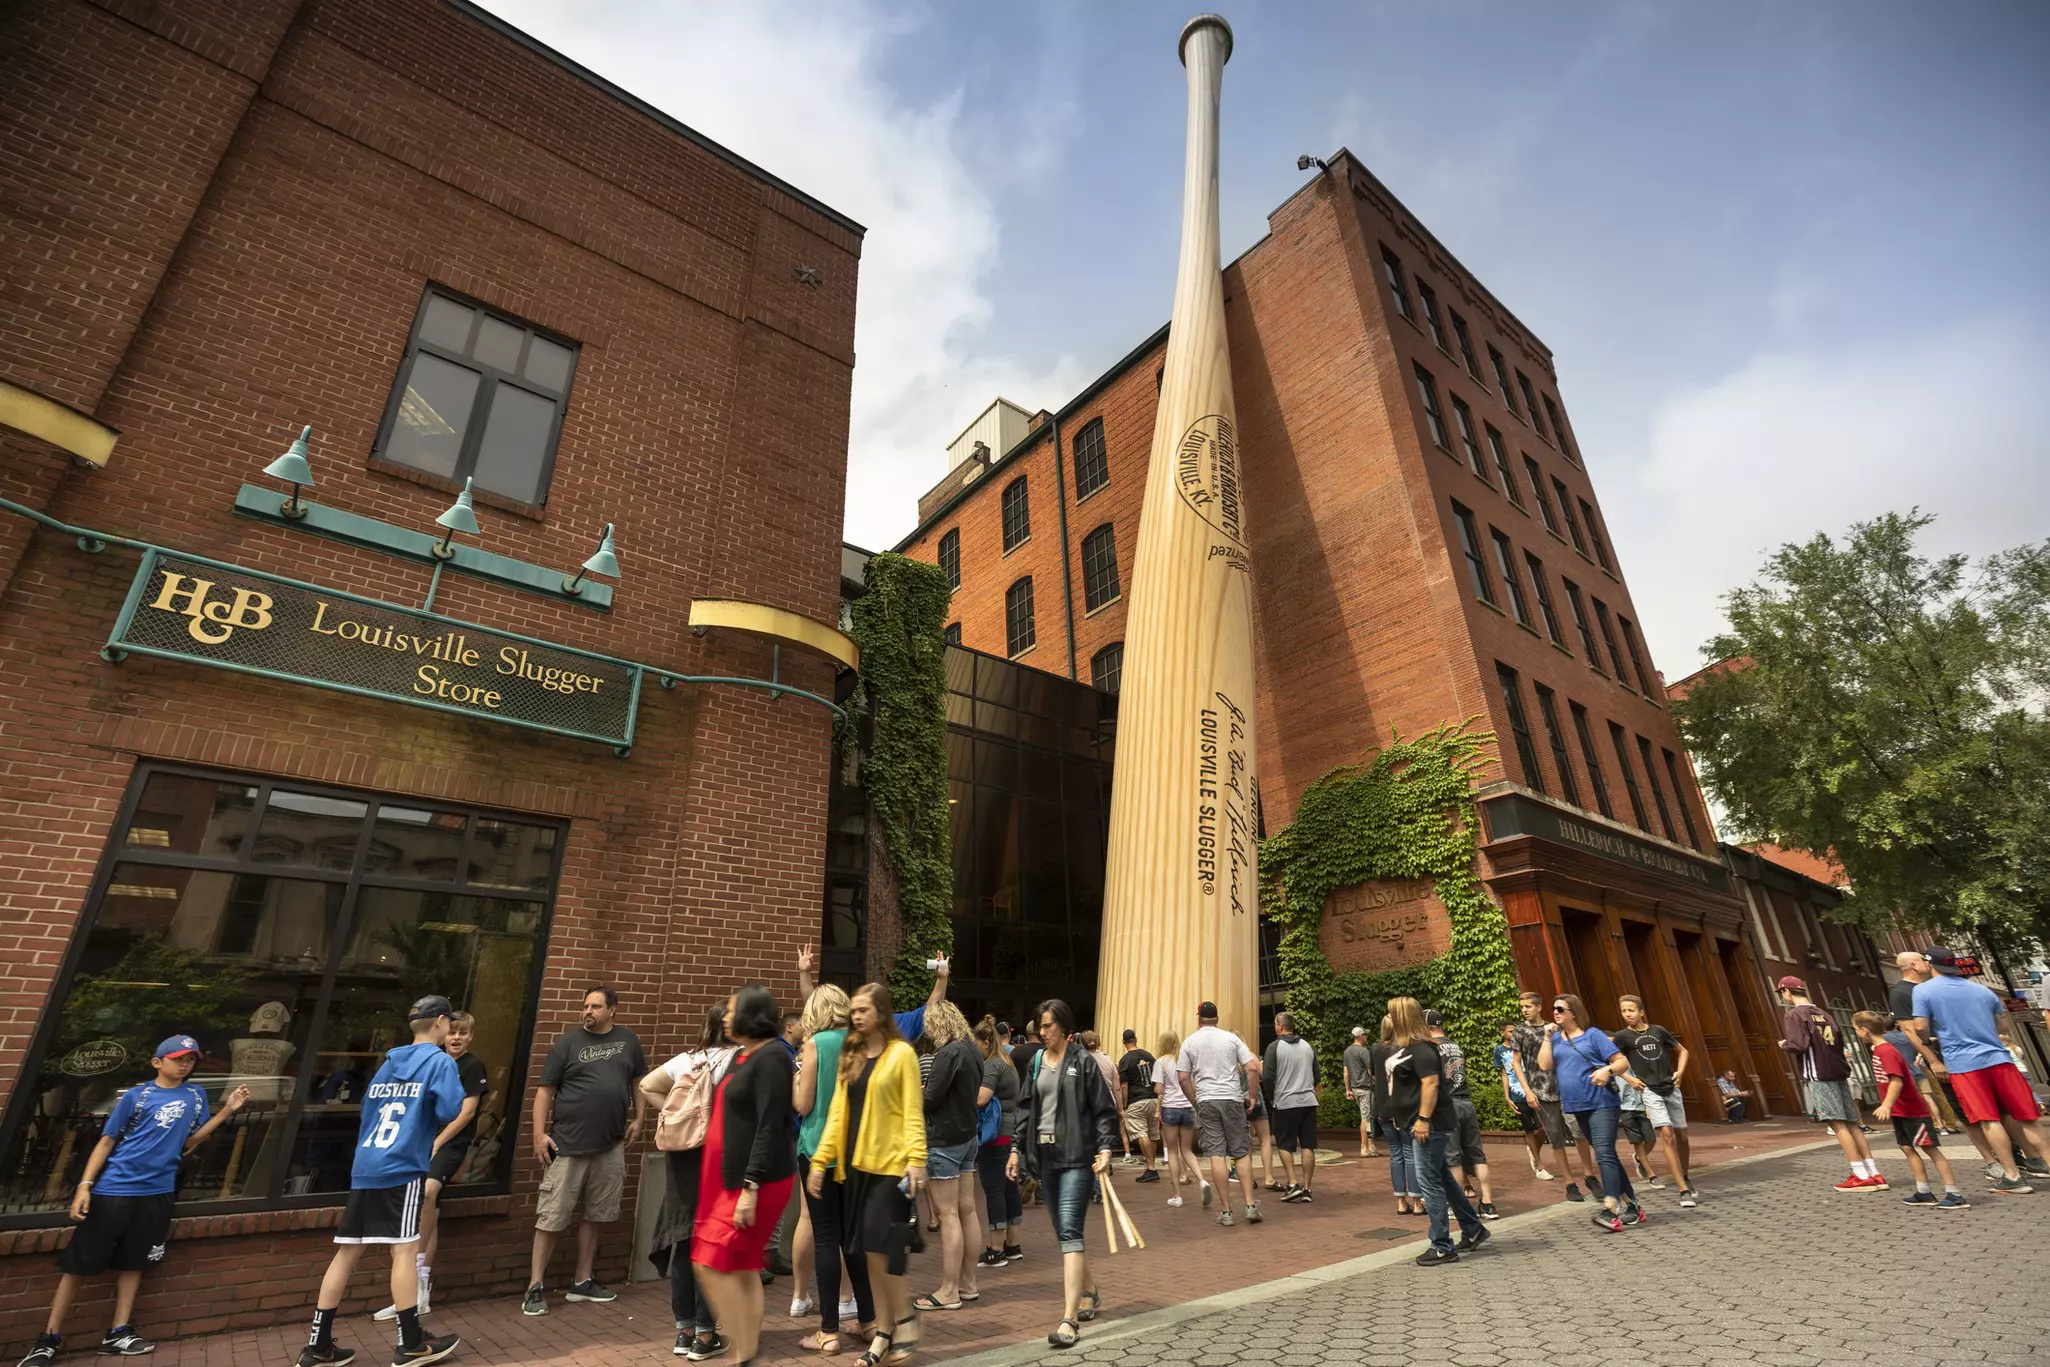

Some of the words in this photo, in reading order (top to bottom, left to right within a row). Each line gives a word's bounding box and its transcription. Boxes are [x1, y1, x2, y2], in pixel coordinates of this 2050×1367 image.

[1209, 440, 1218, 460] MADE
[1216, 418, 1236, 469] HILLERICH
[1211, 463, 1218, 472] IN
[1211, 475, 1220, 499] U.S.A.
[1220, 464, 1236, 477] &
[1221, 473, 1239, 523] BRADSBY
[310, 602, 480, 668] Louisville
[496, 646, 604, 695] Slugger
[413, 665, 501, 709] Store
[1199, 708, 1217, 800] LOUISVILLE
[1250, 776, 1258, 846] GENUINE
[1557, 818, 1627, 858] HILLERICH
[1629, 843, 1641, 862] &
[1641, 847, 1689, 877] BRADSBY
[1332, 881, 1431, 917] Louisville
[1341, 912, 1429, 943] Slugger
[362, 1101, 407, 1149] 16
